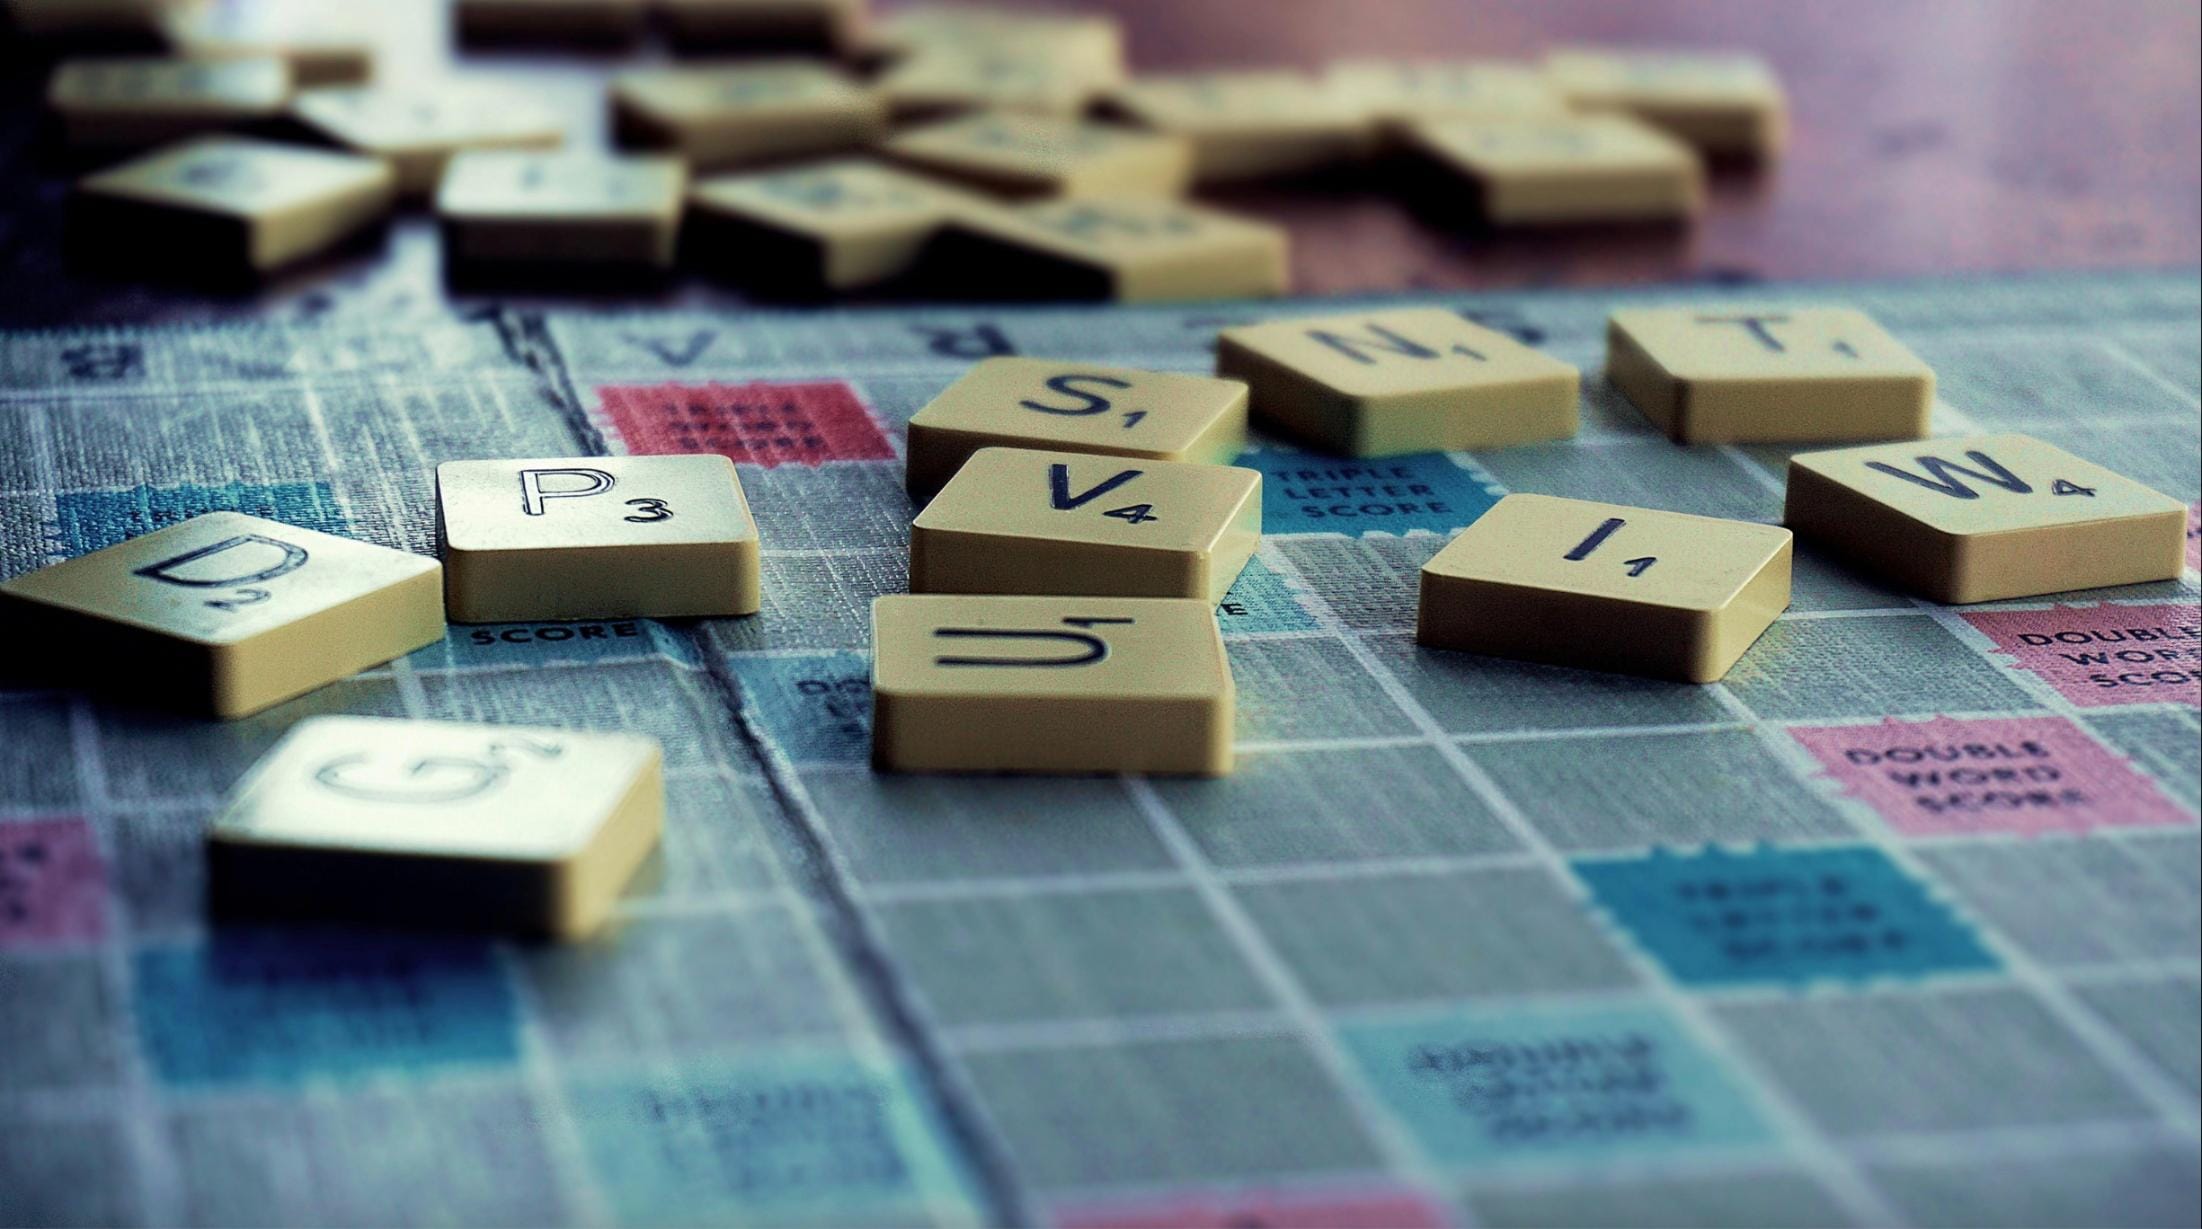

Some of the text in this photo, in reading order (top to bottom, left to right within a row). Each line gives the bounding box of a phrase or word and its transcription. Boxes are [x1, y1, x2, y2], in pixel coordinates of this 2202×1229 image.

[1304, 322, 1442, 366] N
[1451, 343, 1488, 362] 1
[1694, 315, 1791, 352] T
[1018, 374, 1148, 429] S 1
[519, 467, 674, 523] P 3
[1048, 463, 1158, 524] V 4
[1270, 467, 1413, 482] TRIPLE
[1282, 484, 1435, 500] LETTER
[1863, 450, 2097, 500] W 4
[1301, 502, 1454, 519] SCORE
[132, 533, 309, 588] D
[1562, 517, 1657, 578] I 1
[203, 588, 272, 612] 2
[470, 622, 639, 646] SCORE
[933, 617, 1136, 667] U 1
[1845, 740, 2050, 766] DOUBLE
[315, 751, 510, 804] G
